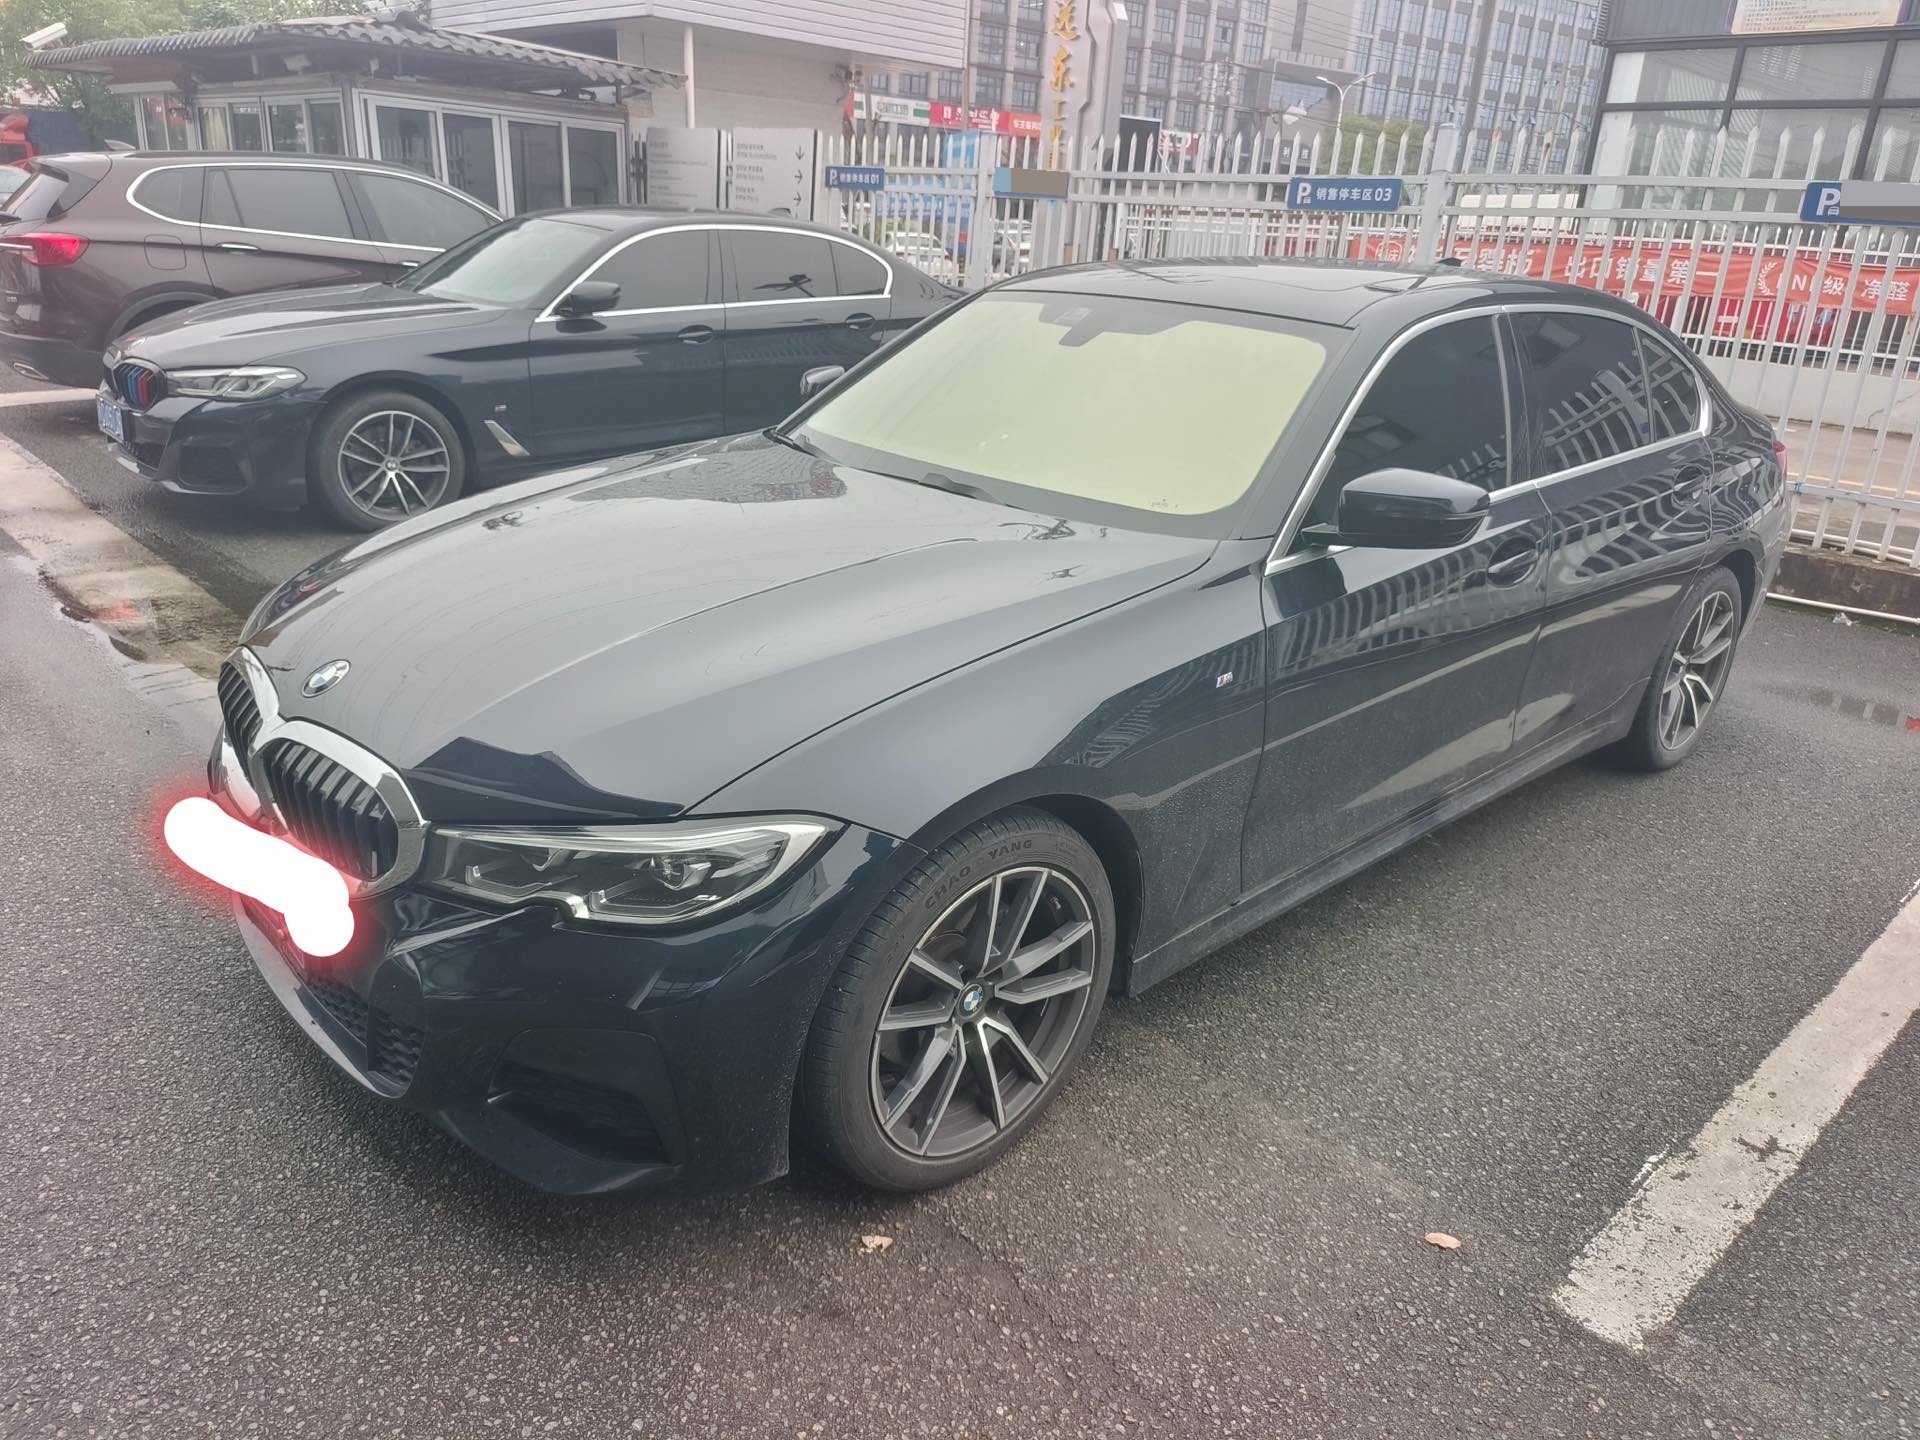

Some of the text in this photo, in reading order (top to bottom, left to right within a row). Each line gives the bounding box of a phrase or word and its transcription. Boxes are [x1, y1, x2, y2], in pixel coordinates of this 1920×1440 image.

[1296, 182, 1312, 205] P
[1816, 187, 1841, 216] P
[1564, 255, 1719, 284] 出口销量第一
[925, 839, 1033, 909] CHAO YANG
